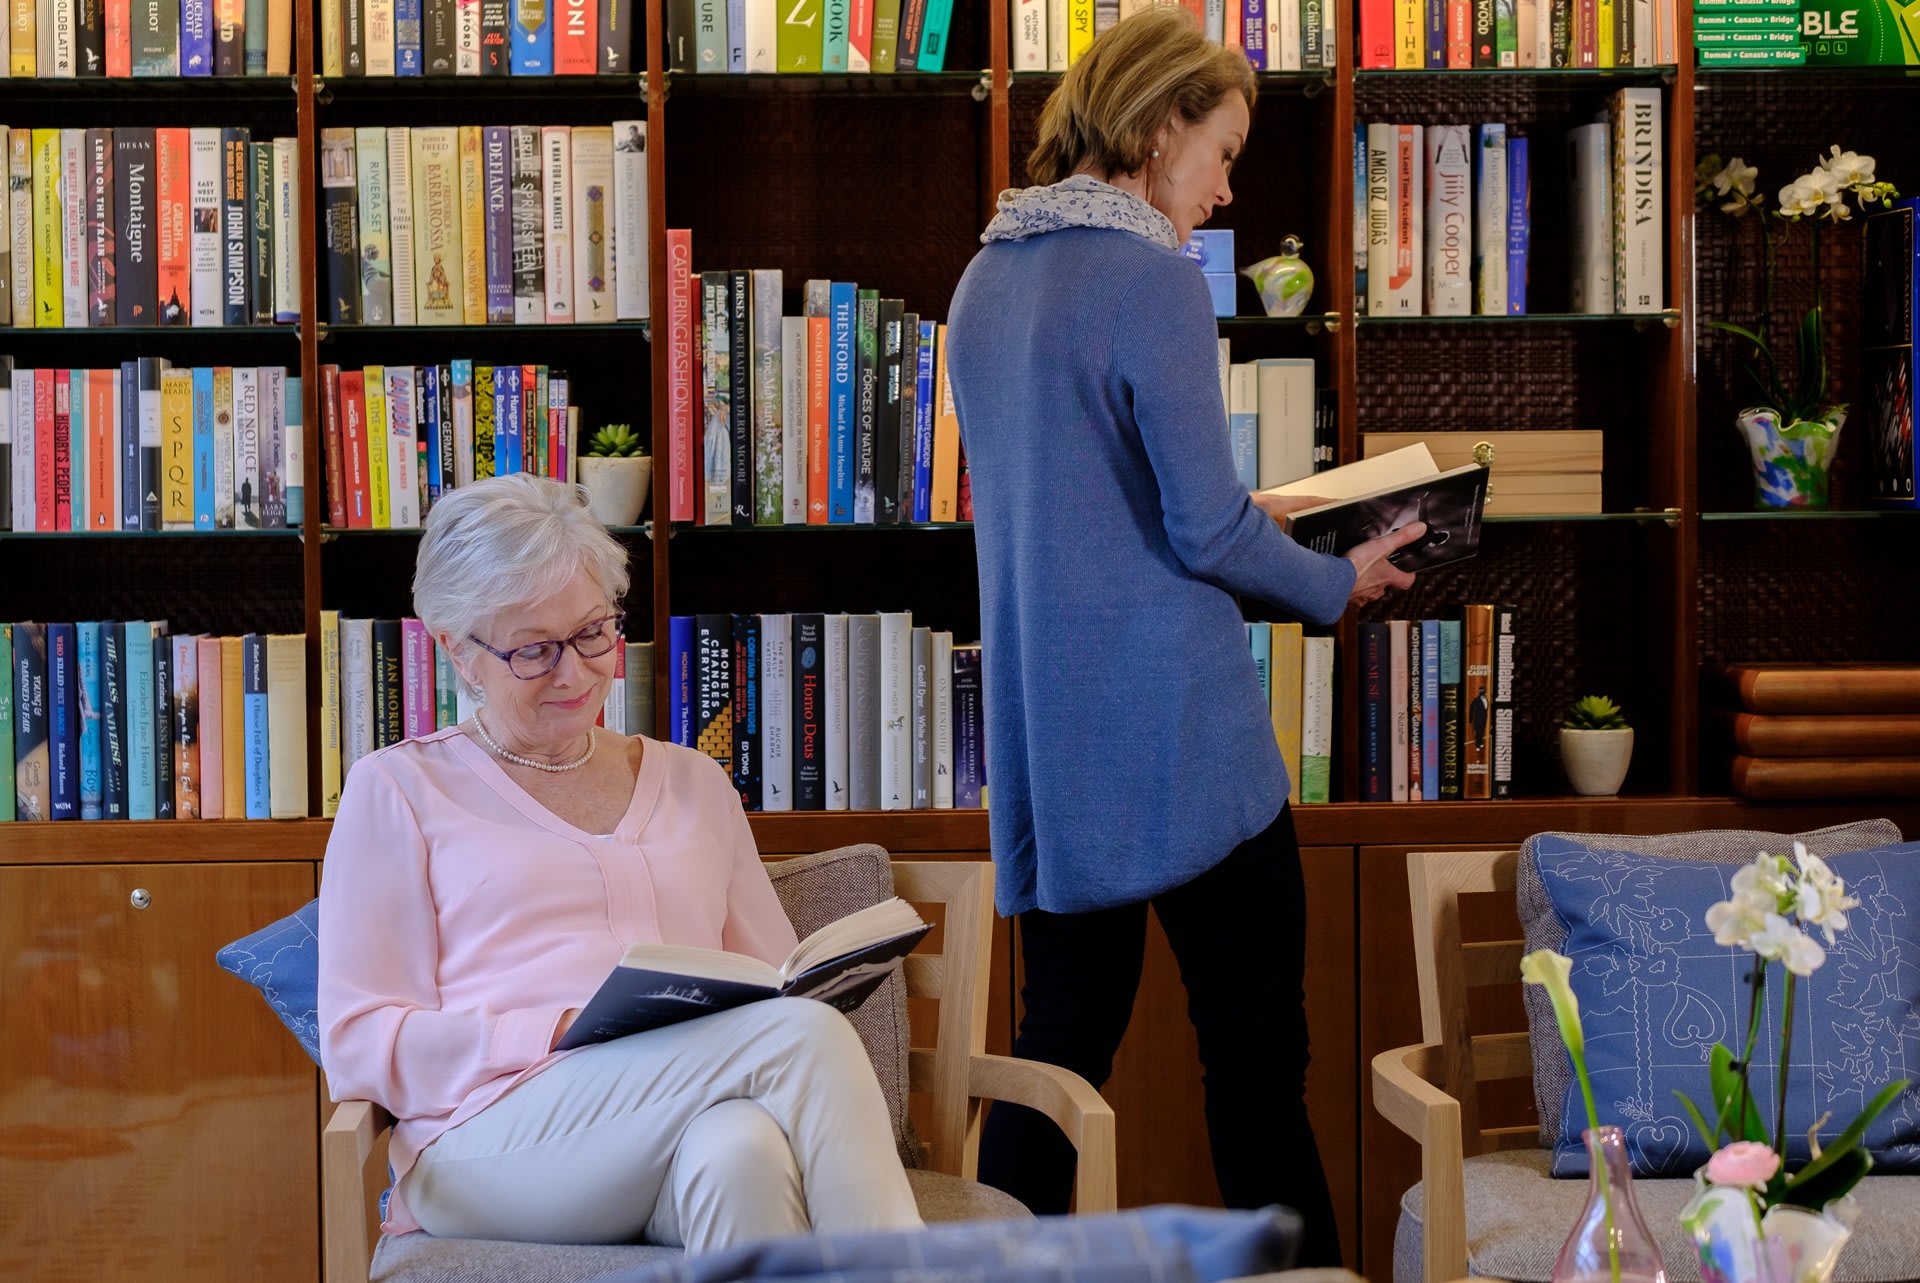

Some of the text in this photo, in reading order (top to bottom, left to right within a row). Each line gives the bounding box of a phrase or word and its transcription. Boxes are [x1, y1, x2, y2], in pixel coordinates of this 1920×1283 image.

[18, 2, 28, 33] ELIOT
[149, 2, 158, 32] ELIOT
[435, 11, 445, 45] Carroll
[1246, 18, 1254, 34] GOES
[1307, 1, 1320, 50] Children
[1770, 34, 1793, 42] Bridge
[1771, 16, 1794, 25] Bridge
[1776, 51, 1800, 59] Bridge
[95, 139, 103, 173] LENIN
[489, 141, 504, 212] DEFIANCE
[552, 147, 560, 162] MAN
[1634, 103, 1653, 226] BRINDISA
[96, 177, 104, 194] ON
[369, 162, 382, 235] RIVIERA SET
[428, 164, 443, 251] BARBAROSSA
[443, 184, 452, 231] FREDERICK
[520, 135, 535, 270] BRUCE SPRINGSTEEN
[553, 180, 561, 194] ALL
[1371, 149, 1387, 246] AMOS OZ JUDAS
[126, 163, 145, 263] Montaigne
[162, 199, 172, 261] REVOLUTION
[174, 203, 183, 241] CAUGHT
[553, 196, 562, 229] MARKETS
[1440, 172, 1465, 278] Jilly Cooper
[97, 222, 105, 256] TRAIN
[227, 205, 244, 305] JOHN SIMPSON
[672, 244, 688, 412] CAPTURING FASHION
[836, 302, 848, 383] THENFORD
[864, 298, 873, 356] BRIAN COX
[36, 380, 45, 421] GENIUS
[735, 276, 746, 485] HORSES PORTRAITS BY DERRY MOORE
[244, 385, 256, 473] RED NOTICE
[348, 400, 356, 437] MICHELIN
[416, 387, 425, 424] Budapest
[496, 395, 505, 435] Budapest
[508, 395, 518, 435] Hungary
[862, 368, 872, 474] FORCES OF NATURE
[57, 415, 69, 462] HISTORY'S
[442, 421, 453, 472] GERMANY
[923, 403, 932, 467] PRIVATE GARDENS
[40, 454, 49, 513] GRAYLING
[57, 467, 69, 504] PEOPLE
[837, 455, 845, 489] Heseltine
[701, 629, 709, 719] EVERYTHING
[710, 639, 719, 708] CHANGES
[720, 649, 729, 699] MONEY
[747, 637, 755, 677] CONTAIN
[1369, 642, 1379, 699] THE MUSE
[1427, 643, 1436, 660] GIRL
[104, 636, 121, 766] THE GLASS UNIVERSE
[386, 657, 398, 741] JAN MORRIS
[747, 680, 755, 734] MULTITUDES
[858, 625, 873, 754] CONVERGENCE
[917, 664, 926, 707] Geoff Dyer
[939, 678, 946, 692] ON
[1427, 679, 1437, 699] EXILE
[139, 671, 150, 786] Elizabeth Jane Howard
[158, 661, 168, 781] In Gratitude JENNY DISKI
[680, 720, 689, 746] Undoing
[681, 706, 689, 719] The
[804, 675, 816, 759] Homo Deus
[1445, 688, 1457, 779] THE WONDER
[741, 741, 749, 775] ED YONG
[918, 715, 926, 763] White Sands
[1495, 708, 1512, 781] SUBMISSION
